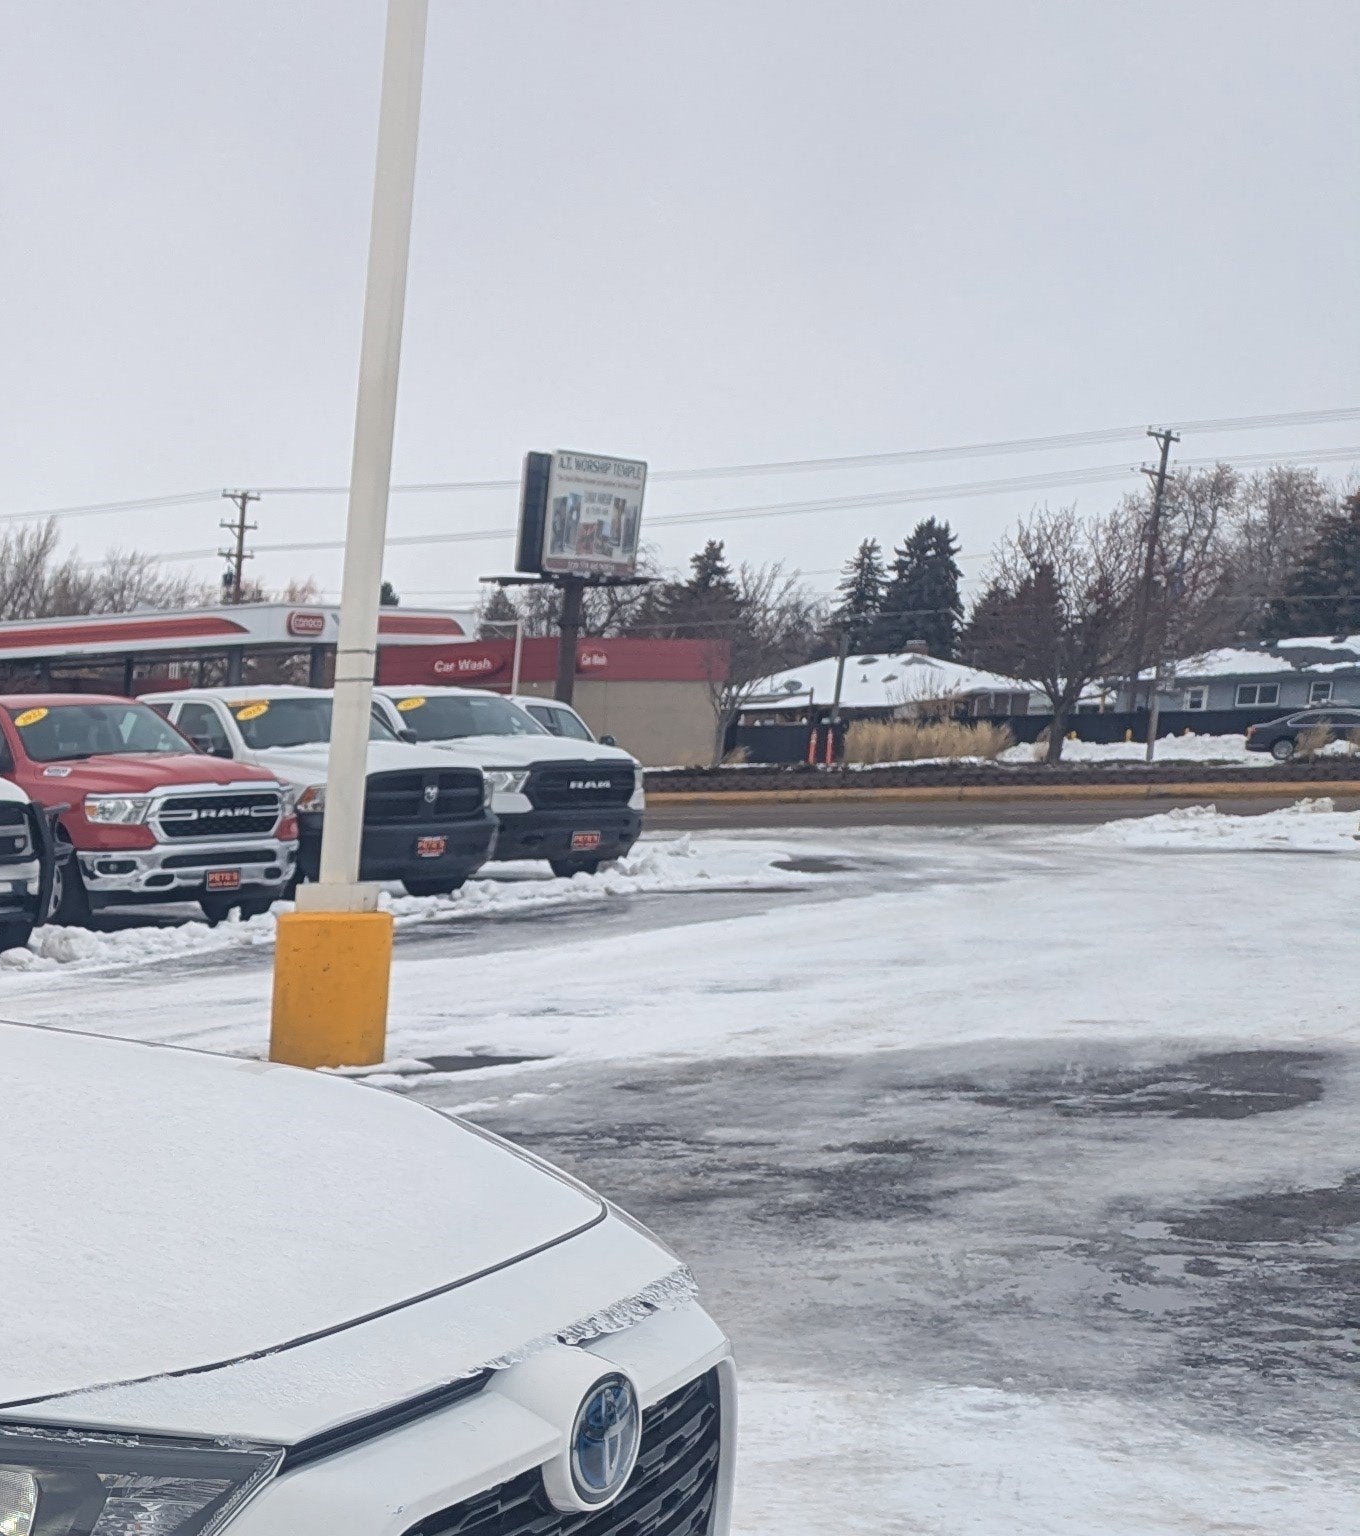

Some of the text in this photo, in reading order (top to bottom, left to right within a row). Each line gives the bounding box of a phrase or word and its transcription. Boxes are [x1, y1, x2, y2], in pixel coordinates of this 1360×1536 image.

[433, 657, 493, 673] Car Wash
[569, 780, 612, 789] RAM
[200, 806, 250, 818] RAM
